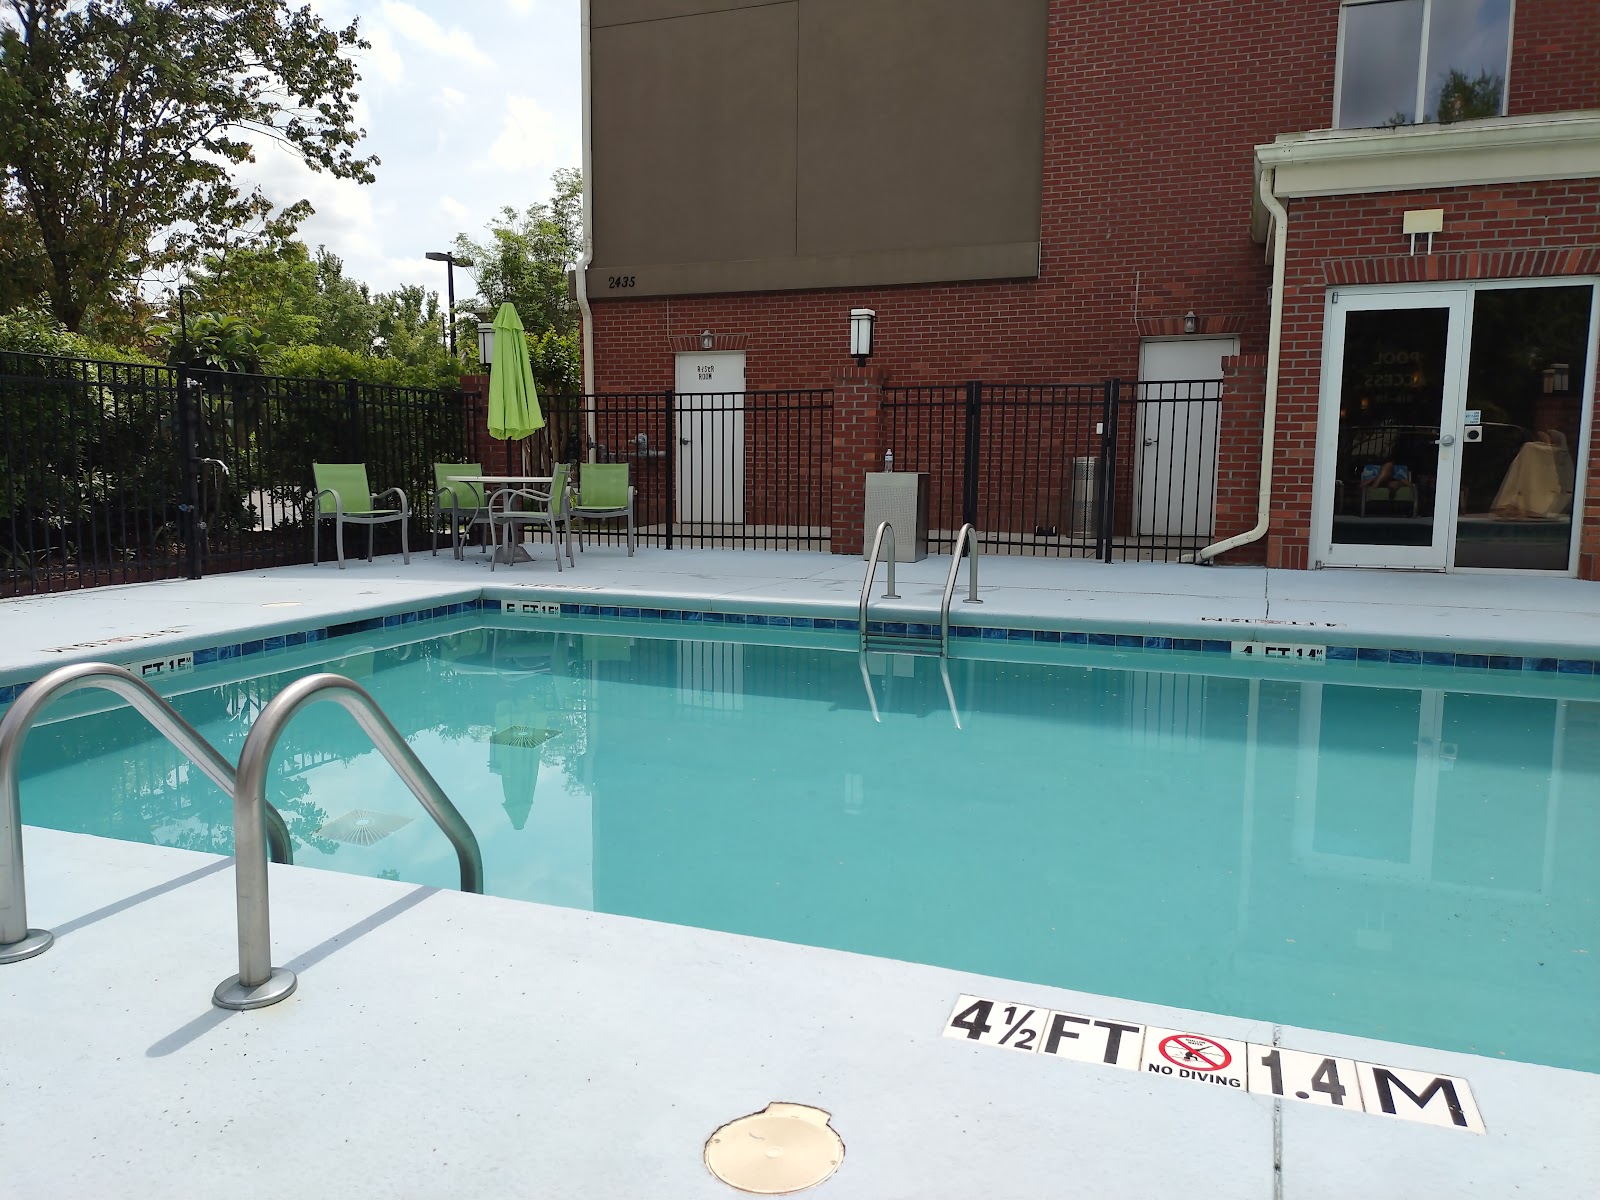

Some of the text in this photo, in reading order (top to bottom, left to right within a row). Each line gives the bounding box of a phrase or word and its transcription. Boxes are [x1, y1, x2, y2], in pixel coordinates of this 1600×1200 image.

[608, 276, 636, 289] 2435
[1044, 1013, 1140, 1066] FT
[1148, 1063, 1241, 1088] NO DIVING
[1260, 1049, 1469, 1128] 1.4 M
